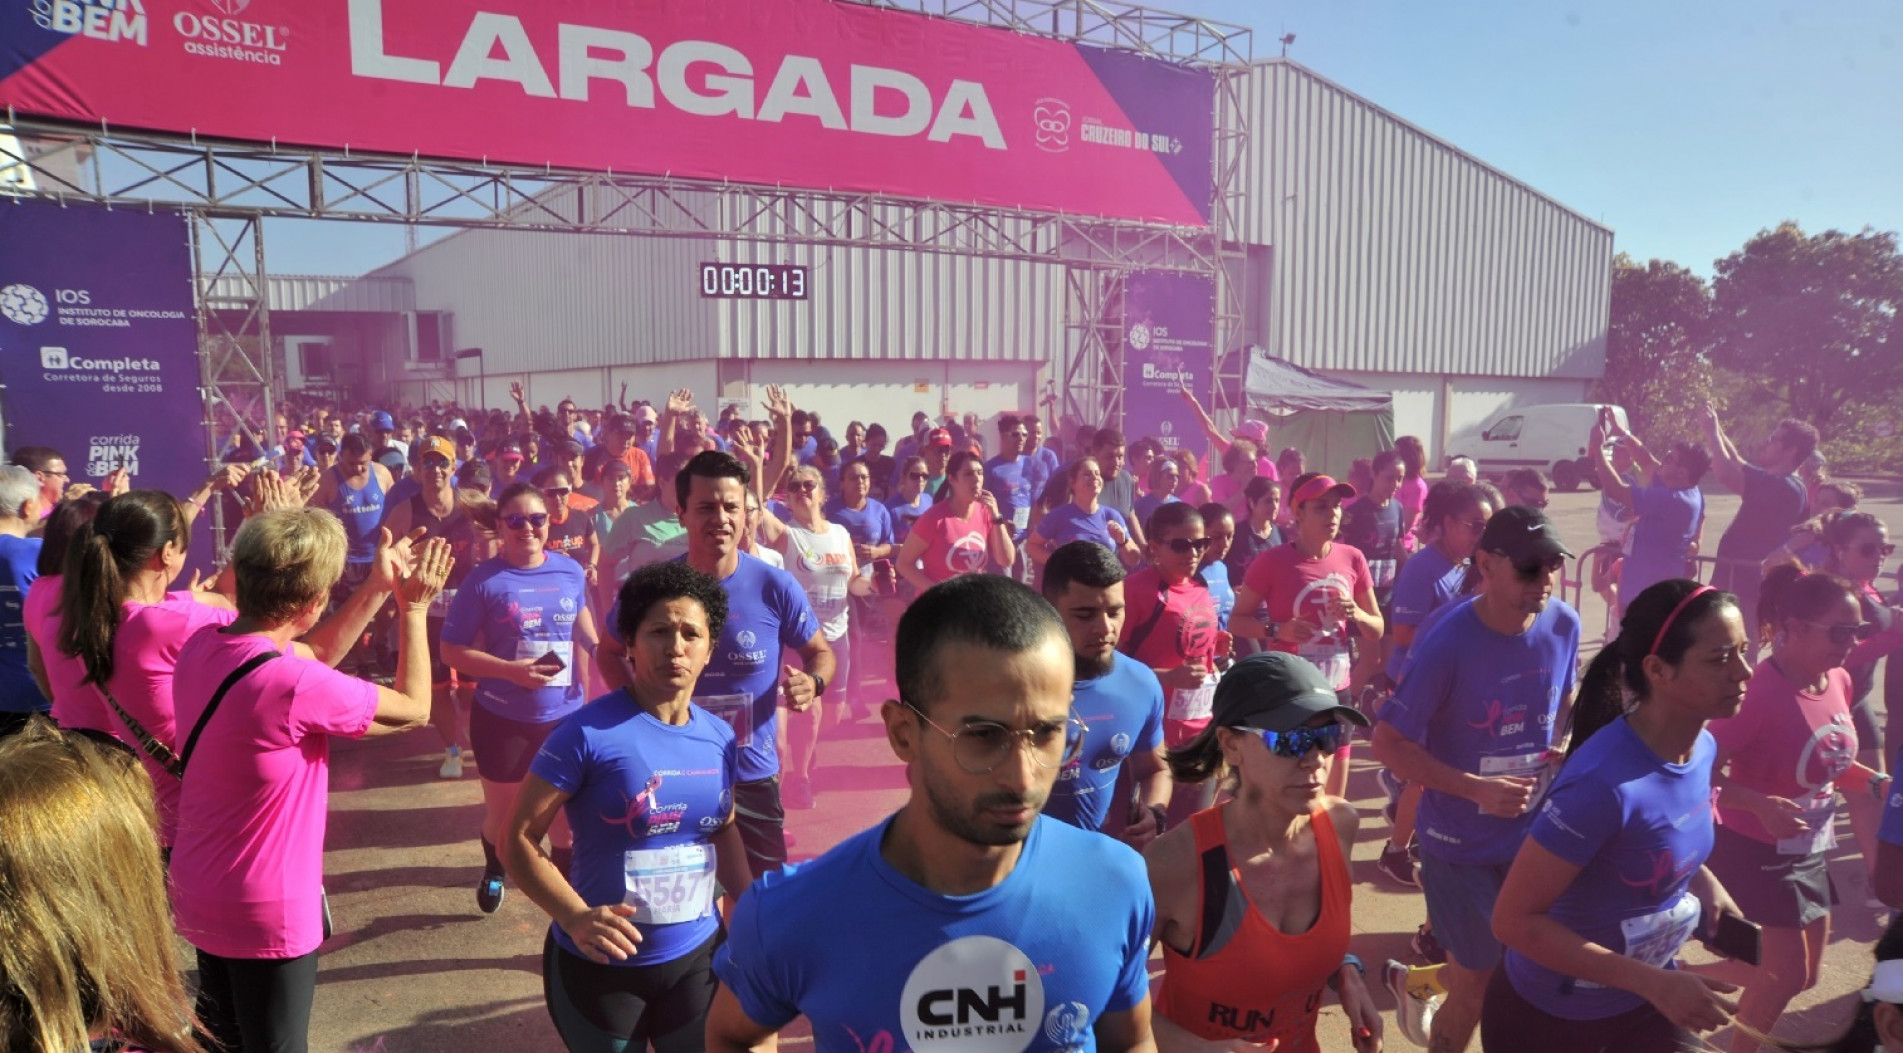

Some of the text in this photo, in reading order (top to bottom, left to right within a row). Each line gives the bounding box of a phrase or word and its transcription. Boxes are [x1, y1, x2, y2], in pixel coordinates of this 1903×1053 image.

[52, 0, 147, 47] BEM
[173, 11, 286, 51] OSSEL
[184, 40, 281, 65] assistência
[348, 0, 1008, 150] LARGADA
[1081, 123, 1170, 154] CRUZEIRO DO SUL
[703, 265, 804, 296] 00:00:13
[55, 289, 91, 305] IOS
[57, 307, 185, 319] INSTITUTO DE ONCOLOGIA
[58, 316, 130, 327] DE SOROCABA
[1153, 326, 1168, 337] IOS
[69, 356, 160, 373] Completa
[43, 372, 161, 384] Corretora de Seguros
[102, 383, 163, 393] desde 2008
[89, 434, 140, 446] corrida
[88, 446, 140, 461] PINK
[728, 650, 767, 661] OSSEL
[917, 972, 1026, 1026] CNH
[1208, 1001, 1276, 1033] RUN
[916, 1023, 1026, 1041] INDUSTRIAL
